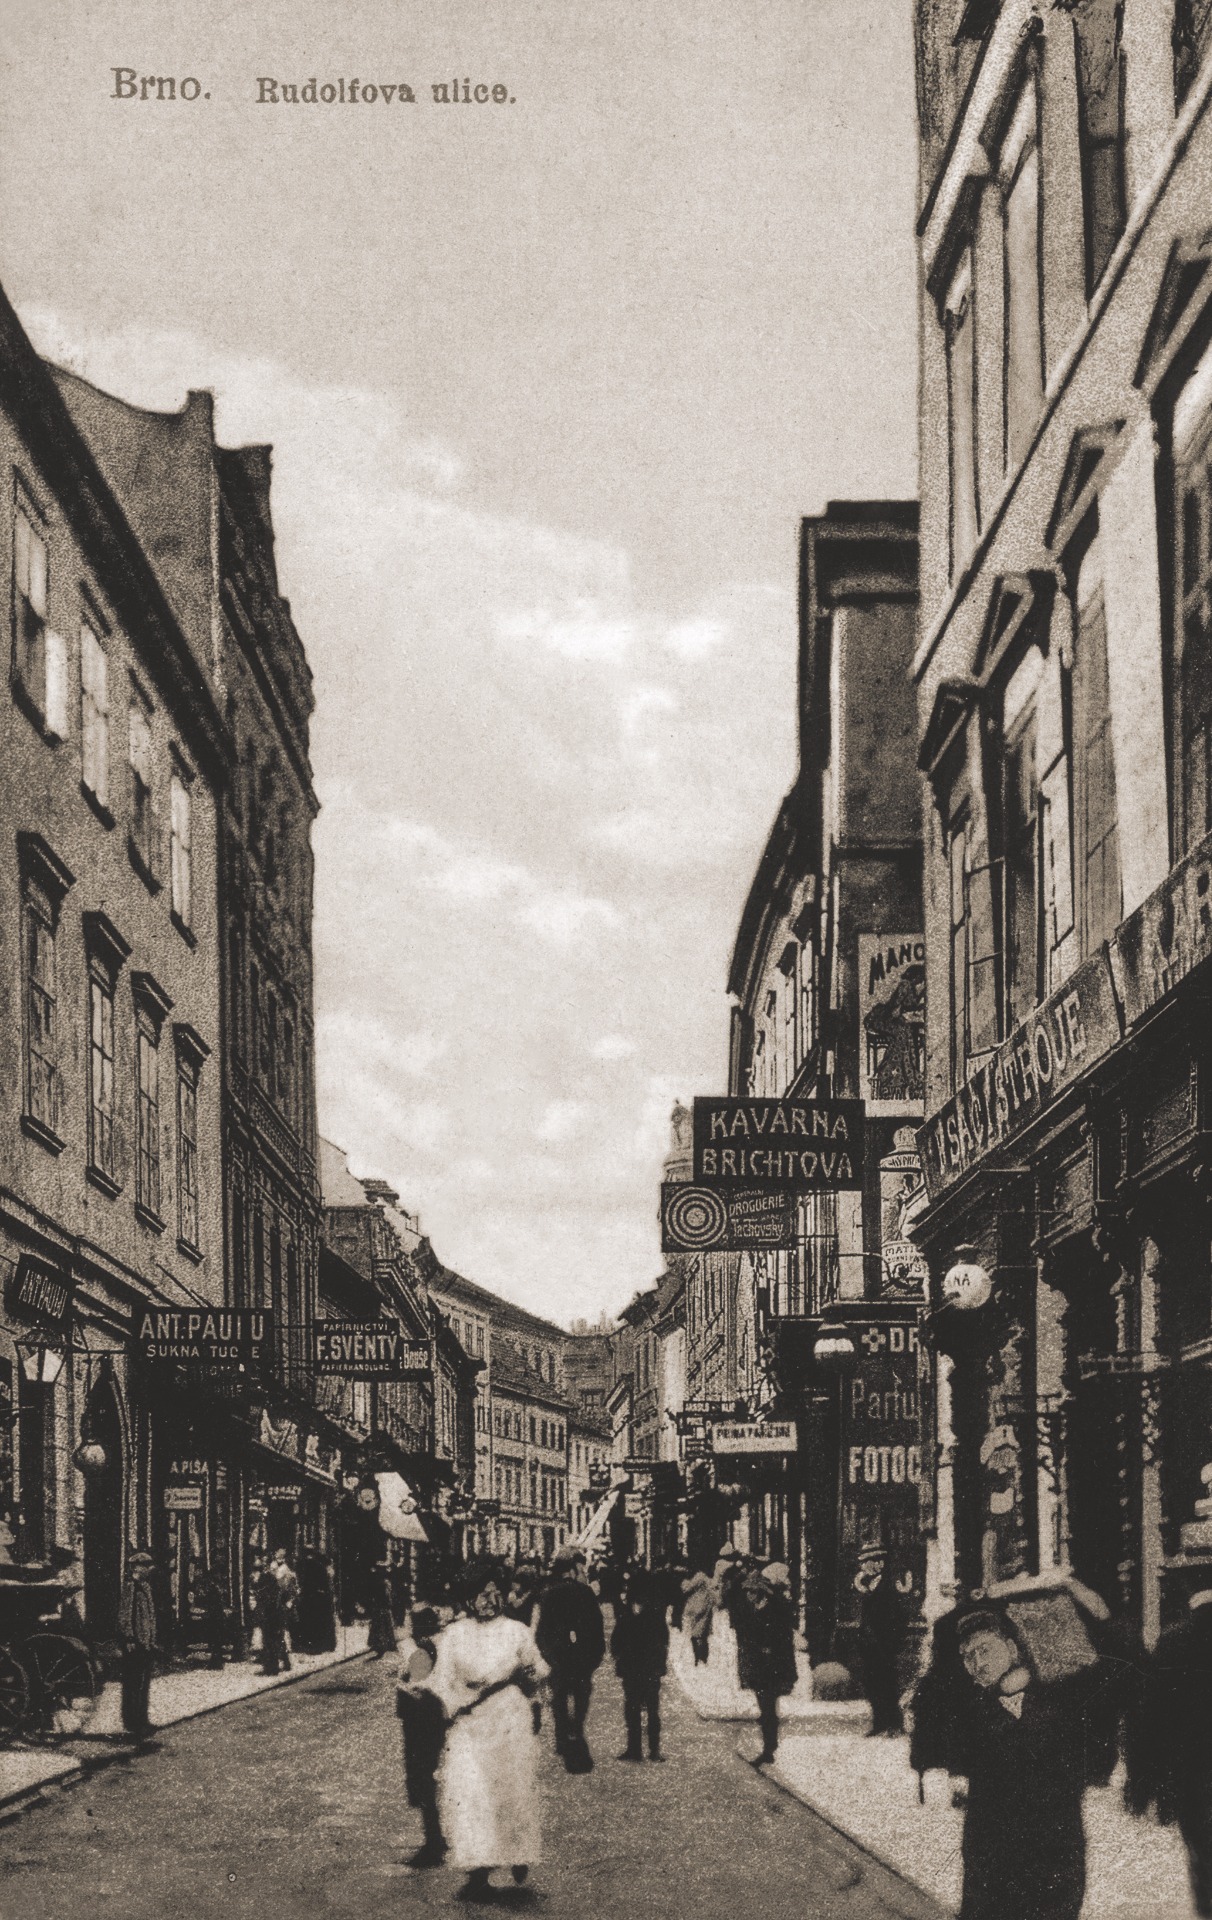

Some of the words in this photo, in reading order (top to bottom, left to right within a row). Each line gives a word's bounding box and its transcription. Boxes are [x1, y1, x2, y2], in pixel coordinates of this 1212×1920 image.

[709, 1102, 849, 1141] KAVÁRNA
[702, 1148, 853, 1179] BRICHTOVA
[729, 1194, 785, 1216] DROGUERIE
[146, 1344, 200, 1357] SUKNA
